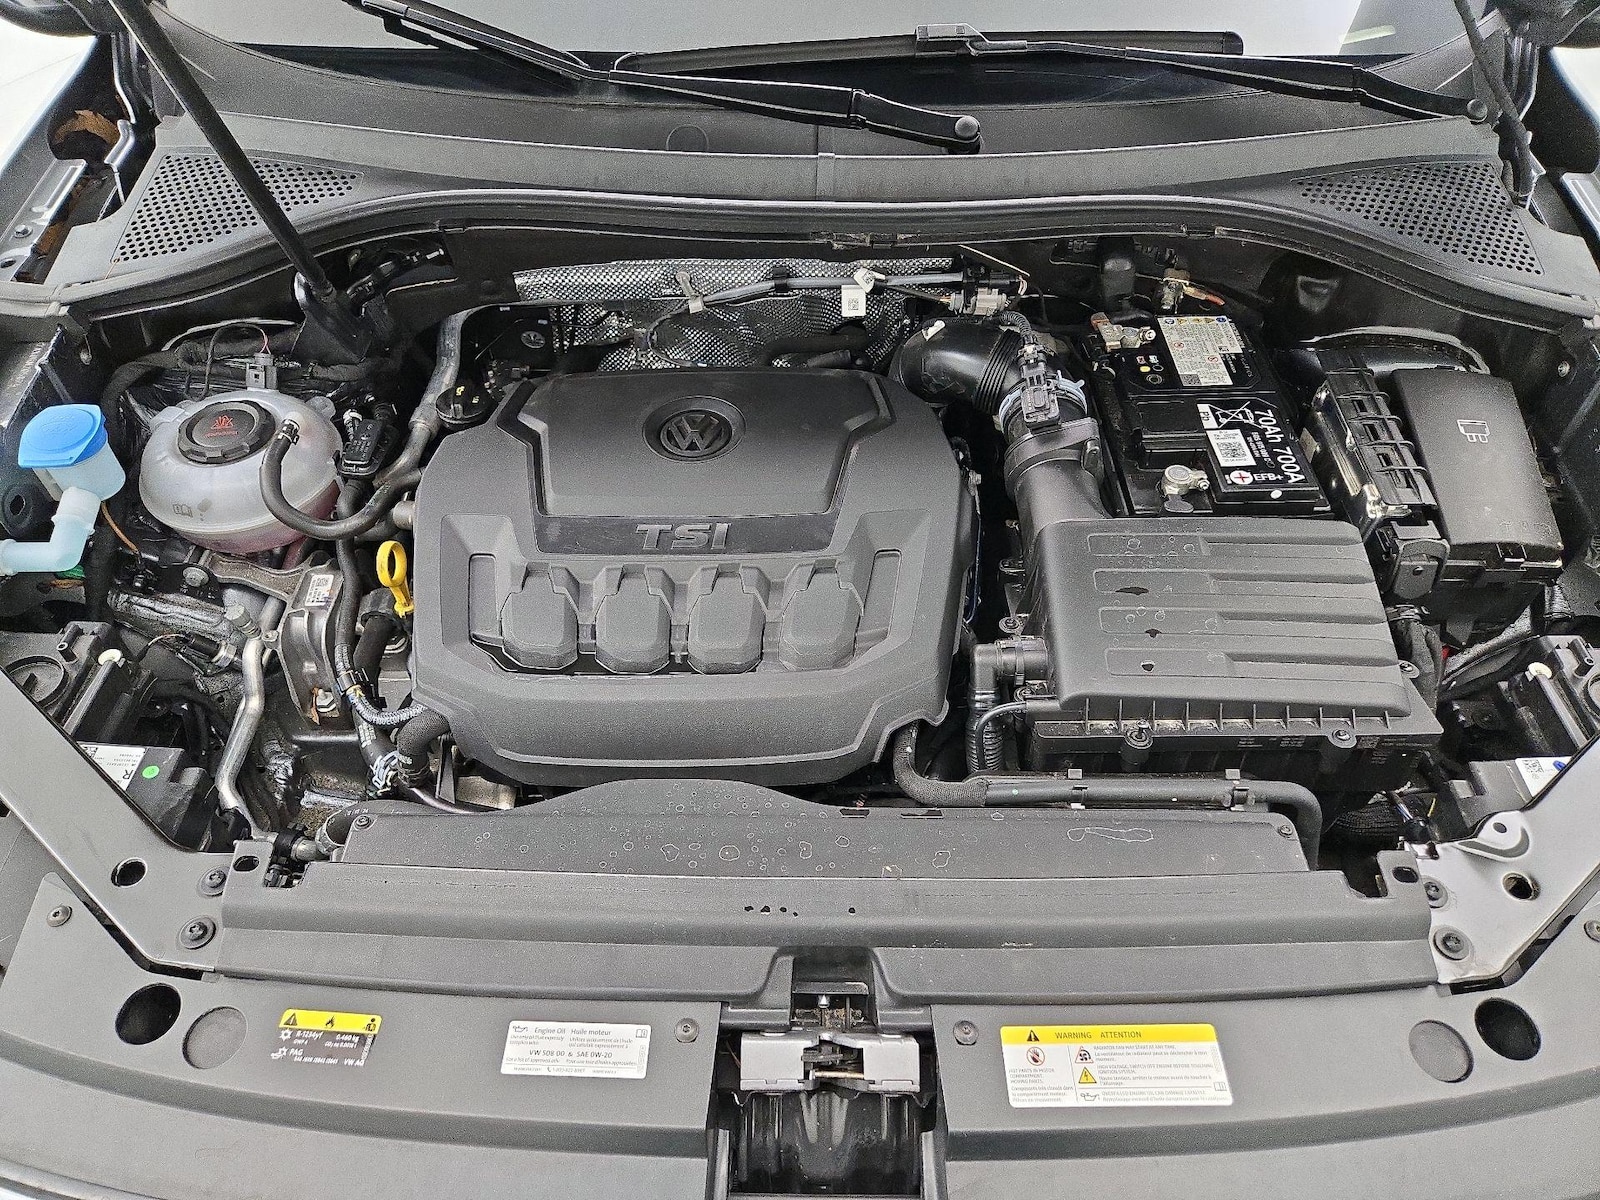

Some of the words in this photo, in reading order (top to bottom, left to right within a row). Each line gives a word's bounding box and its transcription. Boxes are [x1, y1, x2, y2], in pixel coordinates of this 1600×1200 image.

[1255, 410, 1283, 442] 70Ah
[1274, 447, 1306, 483] 700A
[1254, 472, 1284, 482] EFB+
[636, 523, 731, 550] TSI
[122, 770, 134, 780] R
[296, 1030, 324, 1041] R-1234yf
[534, 1027, 555, 1036] Engine
